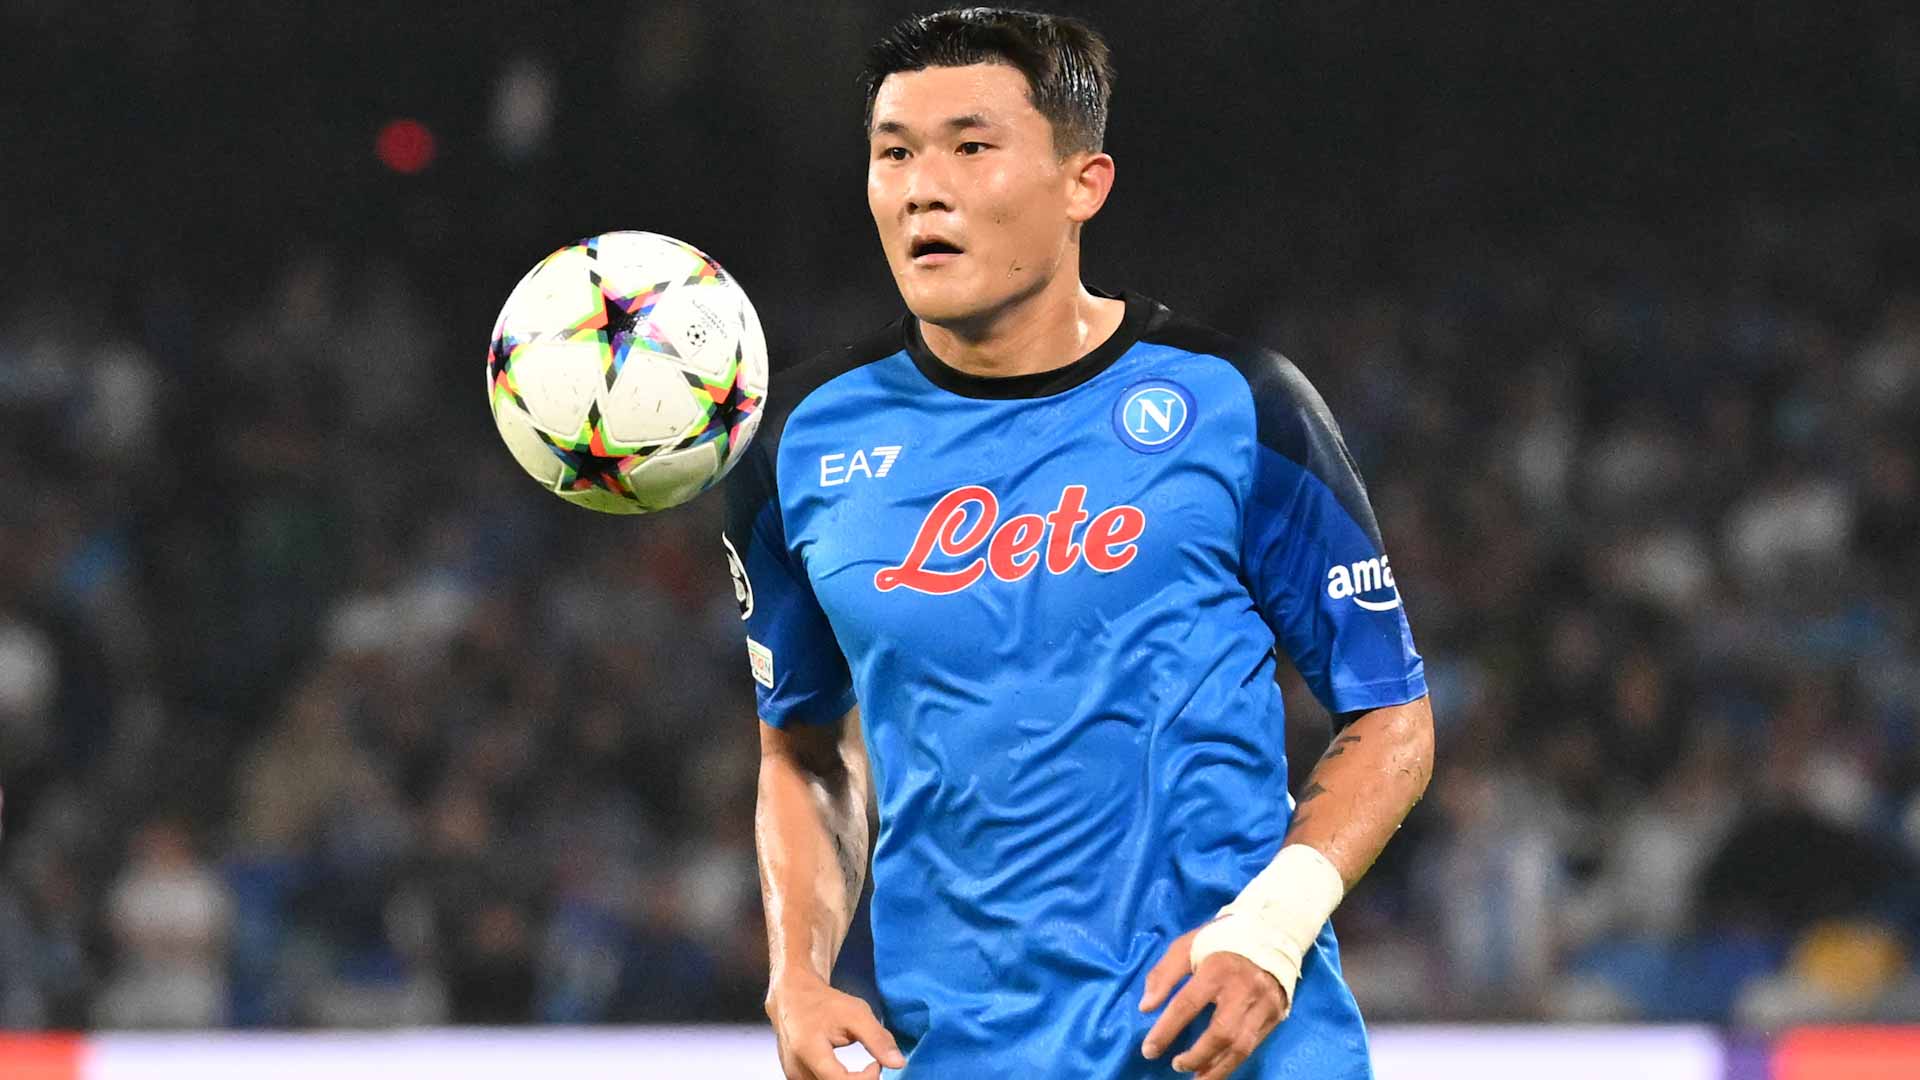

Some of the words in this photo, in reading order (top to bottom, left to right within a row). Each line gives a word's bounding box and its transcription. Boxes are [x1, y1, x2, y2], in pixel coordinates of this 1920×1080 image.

[1135, 398, 1177, 433] N
[820, 445, 904, 487] EA7
[873, 484, 1146, 595] Lete
